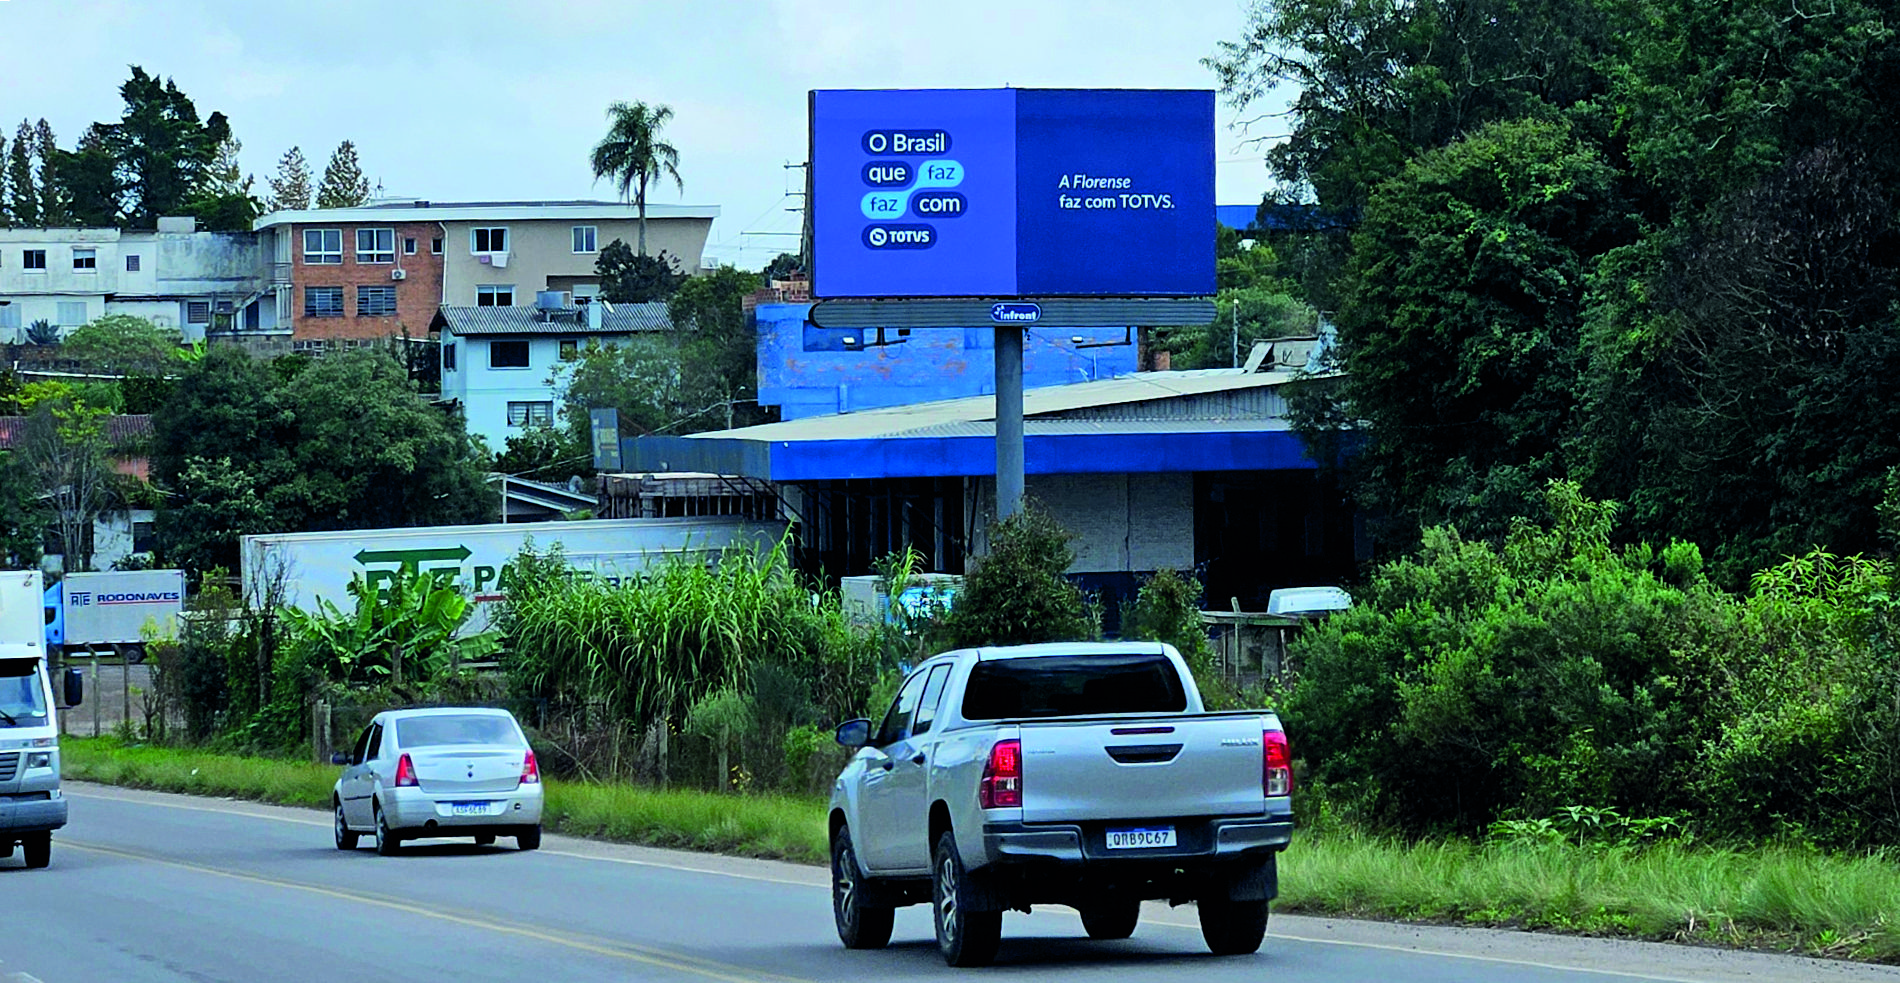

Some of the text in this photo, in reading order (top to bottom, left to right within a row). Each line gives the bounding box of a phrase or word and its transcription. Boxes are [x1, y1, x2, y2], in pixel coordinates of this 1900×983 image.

[869, 132, 945, 152] O Brasil
[869, 164, 956, 183] que faz
[1058, 173, 1132, 189] A Florense
[870, 196, 961, 213] faz com
[1059, 193, 1175, 209] faz com TOTVS.
[888, 230, 931, 243] TOTVS
[1000, 310, 1037, 320] infront
[69, 591, 180, 607] RTE RODONAVES
[1113, 832, 1169, 846] QRB9C67
